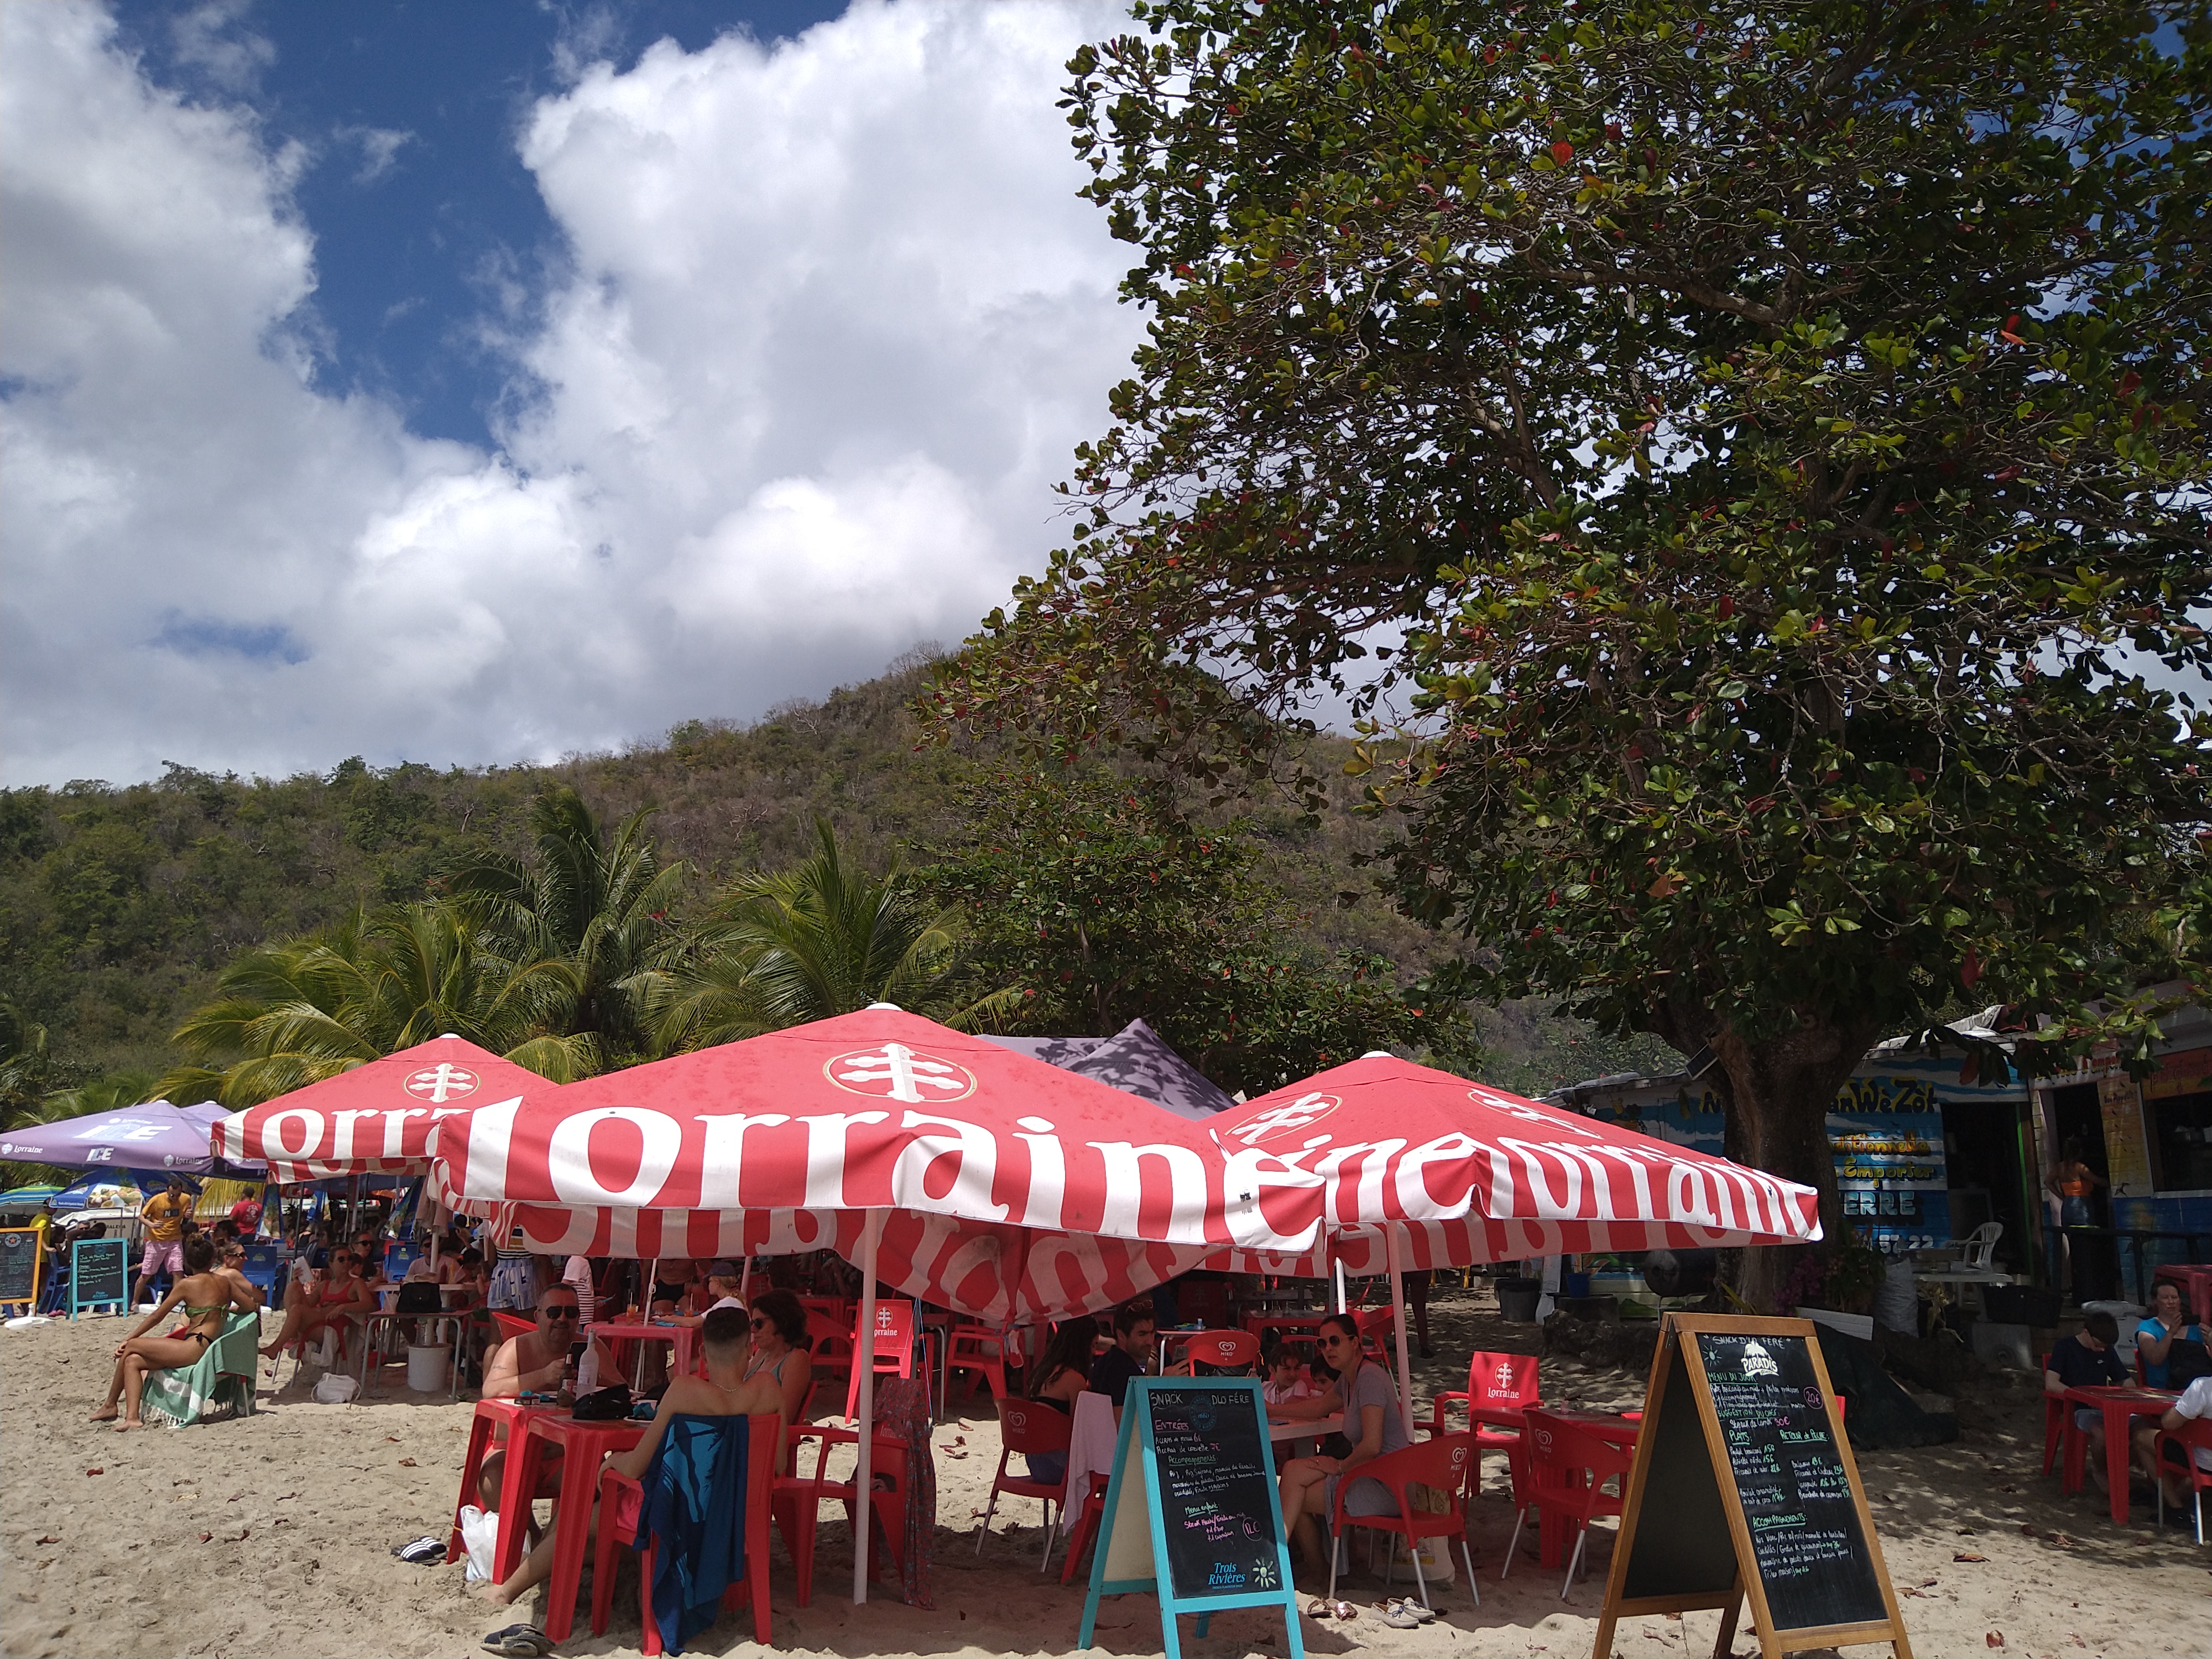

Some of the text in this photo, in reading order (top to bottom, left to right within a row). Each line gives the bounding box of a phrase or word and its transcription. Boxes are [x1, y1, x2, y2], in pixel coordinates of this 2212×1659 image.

[73, 1124, 173, 1141] ICE
[14, 1145, 43, 1154] Lorraine
[86, 1147, 114, 1162] ICE
[464, 1096, 1326, 1253] lorraine
[1843, 1157, 1934, 1188] Emporter
[1841, 1191, 1916, 1216] ERRE
[874, 1328, 898, 1337] orraine
[1713, 1335, 1738, 1345] SNACK
[1707, 1371, 1727, 1383] MENU
[1728, 1372, 1737, 1382] DU
[1150, 1391, 1183, 1406] SNACK
[1487, 1387, 1520, 1399] Lorraine
[1806, 1390, 1821, 1405] 20€
[1717, 1408, 1753, 1418] SUGGESTION
[1155, 1418, 1190, 1431] ENTRÉES
[1773, 1416, 1790, 1426] 30€
[1779, 1429, 1803, 1440] RETOUR
[1214, 1562, 1237, 1573] Trois
[1208, 1573, 1246, 1585] Rivières
